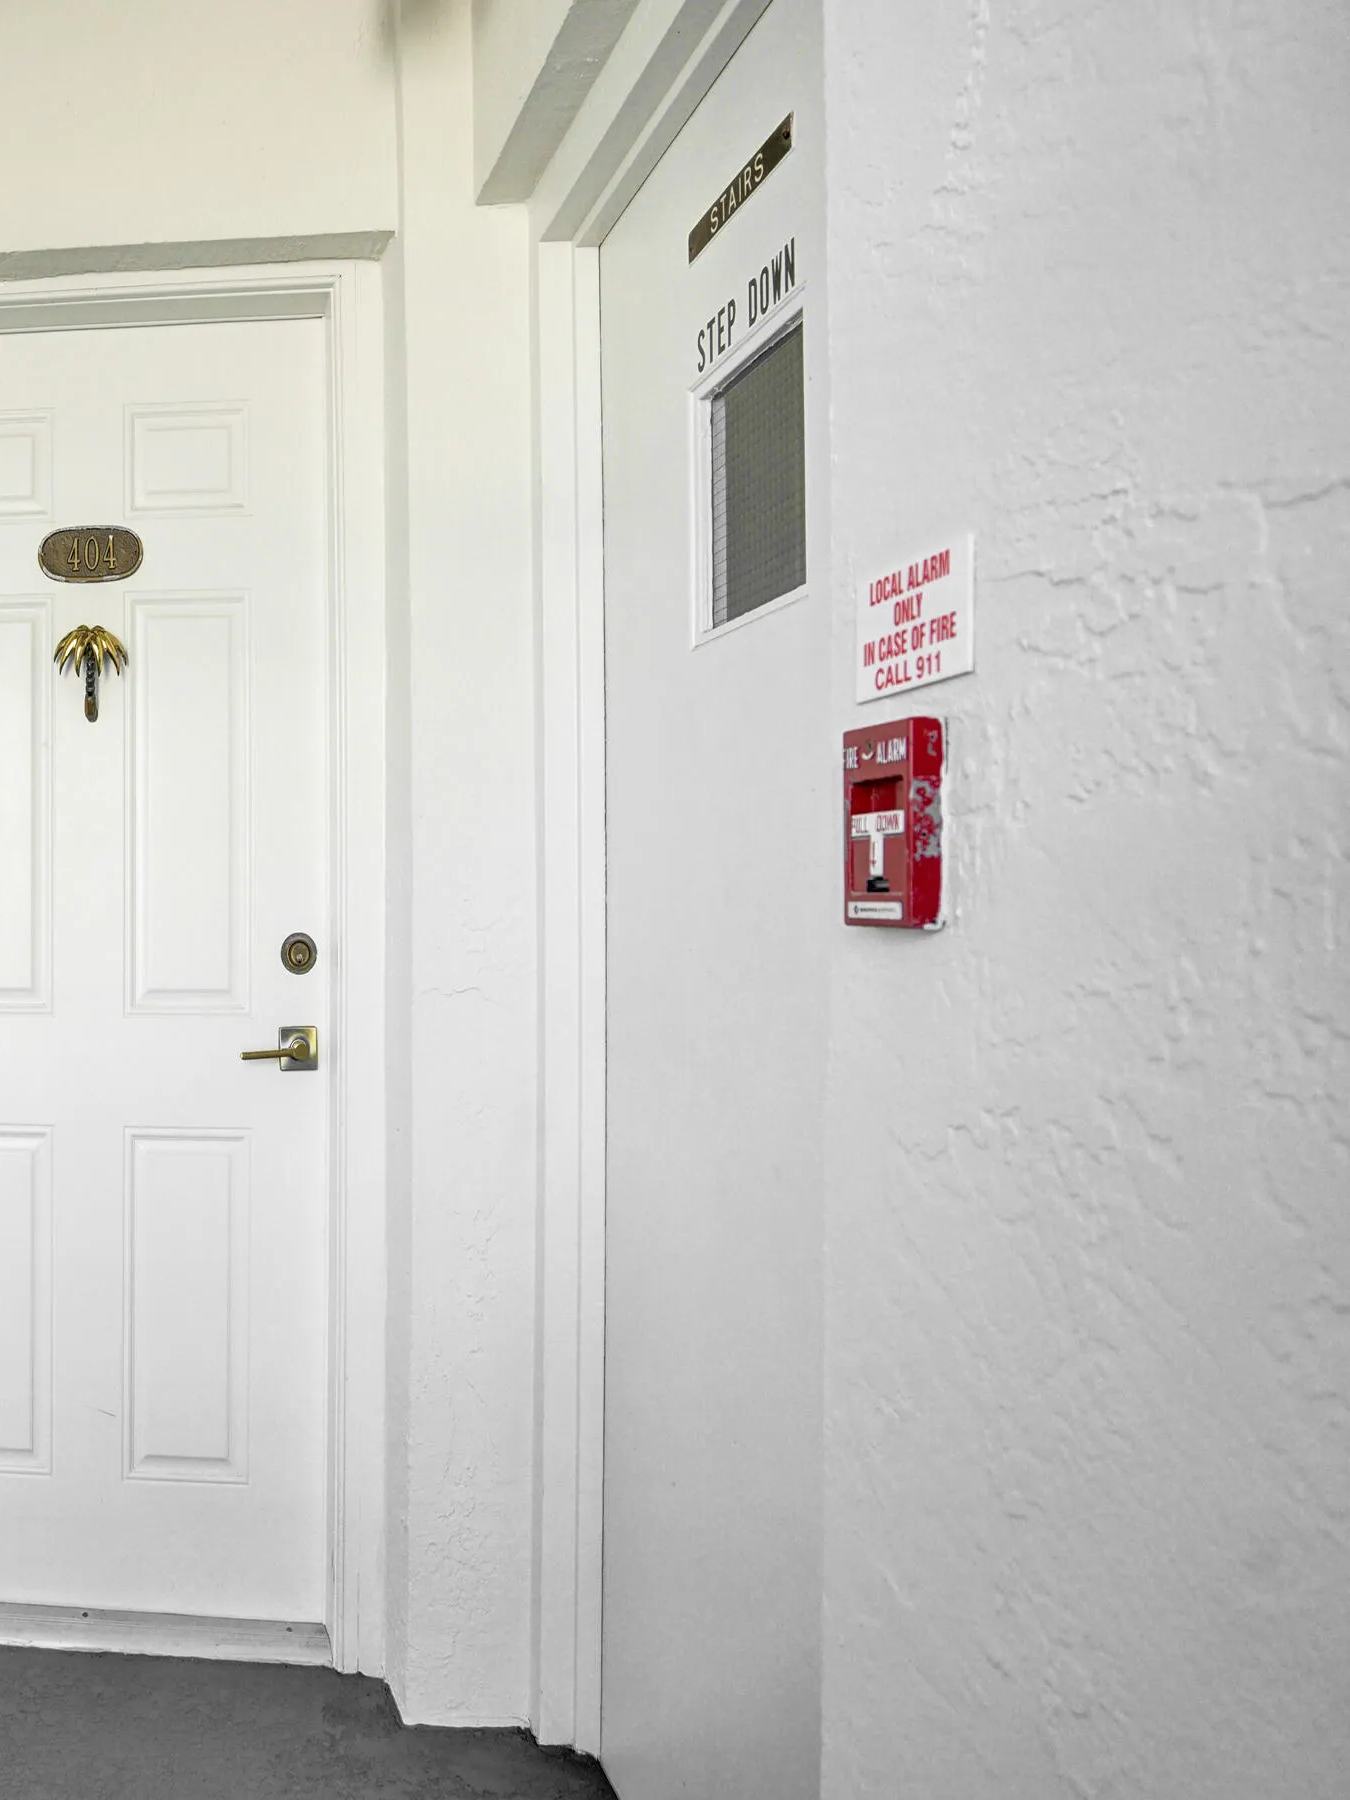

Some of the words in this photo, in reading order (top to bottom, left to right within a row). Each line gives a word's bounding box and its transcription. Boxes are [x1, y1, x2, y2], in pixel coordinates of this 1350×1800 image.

[710, 152, 765, 233] STAIRS
[697, 299, 736, 373] STEP
[748, 237, 796, 328] DOWN
[67, 535, 117, 571] 404
[869, 570, 904, 607] LOCAL
[907, 549, 950, 591] ALARM
[893, 593, 924, 627] ONLY
[863, 641, 875, 667] IN
[878, 629, 907, 662] CASE
[911, 622, 926, 650] OF
[930, 611, 957, 645] FIRE
[875, 660, 912, 691] CALL
[916, 651, 941, 679] 911
[876, 737, 907, 764] ALARM
